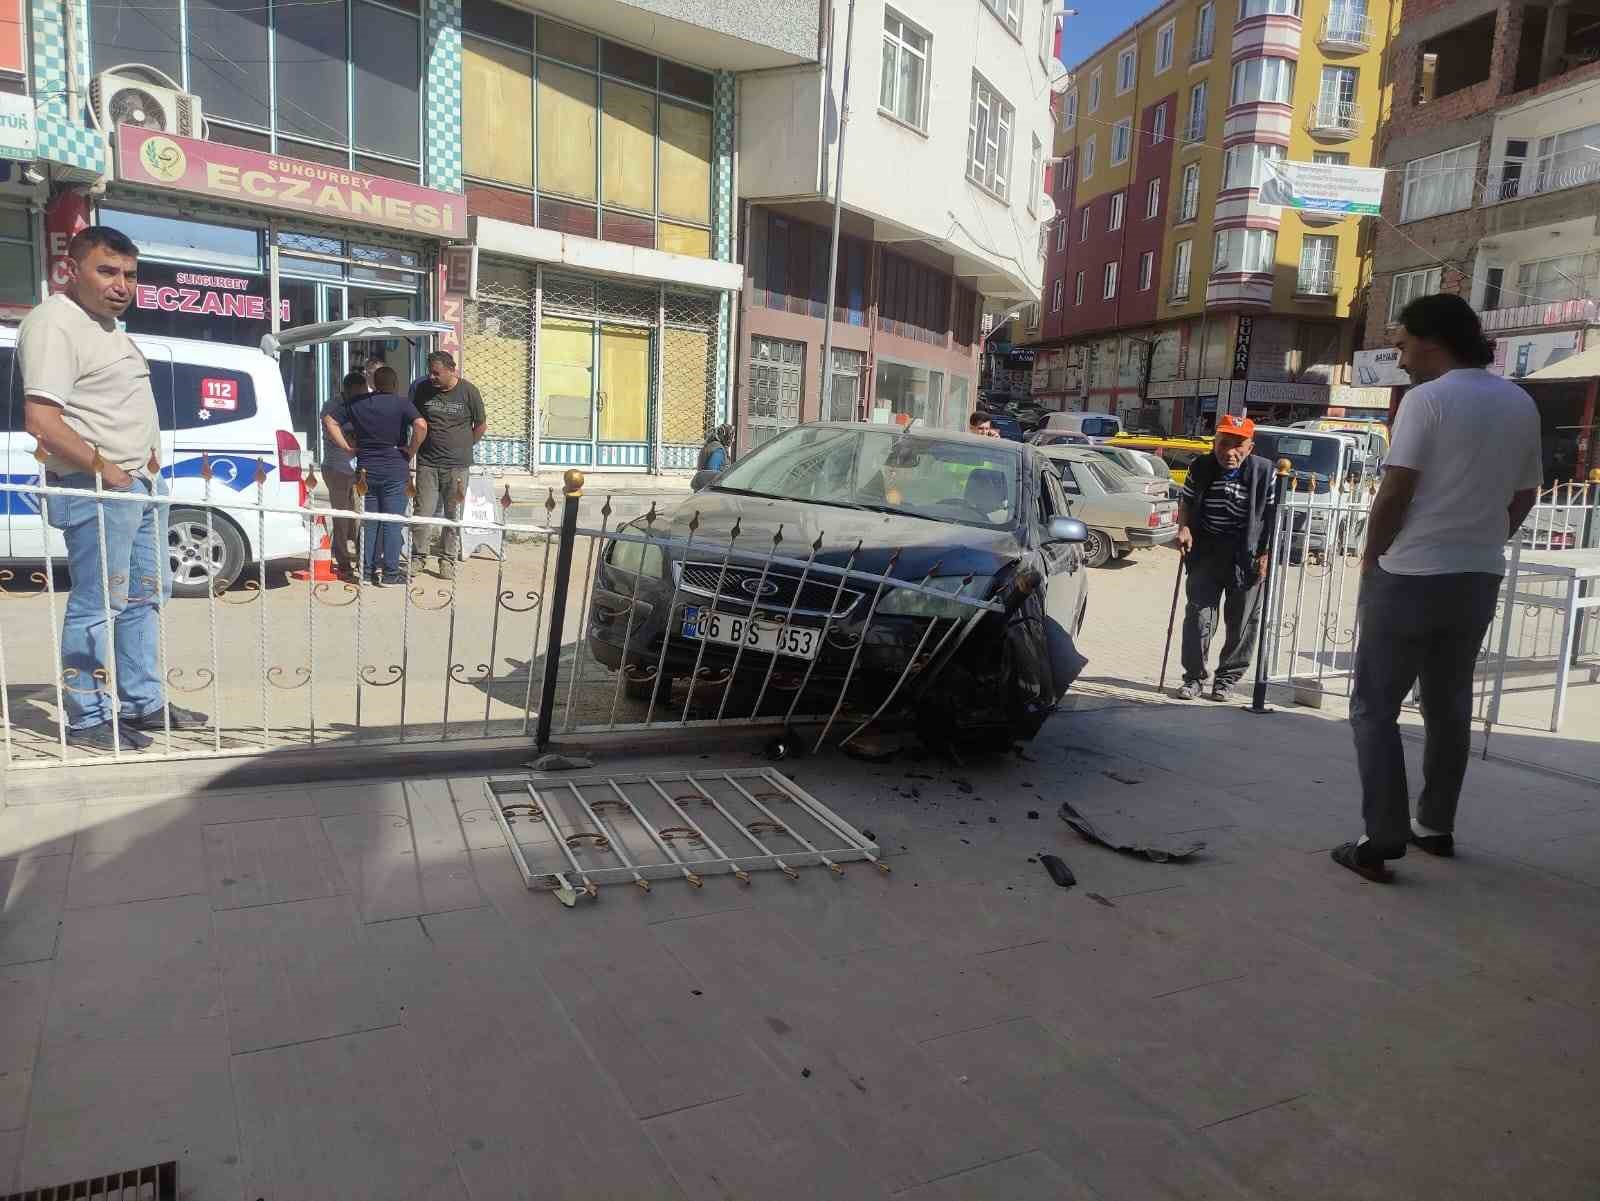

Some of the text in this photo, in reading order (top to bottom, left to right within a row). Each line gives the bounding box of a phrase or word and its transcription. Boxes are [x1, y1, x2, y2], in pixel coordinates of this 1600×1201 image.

[268, 160, 372, 190] SUNGURBEY
[206, 160, 454, 231] ECZANESİ
[176, 272, 248, 290] SUNGURBEY
[1236, 317, 1252, 370] BUHARA
[208, 382, 232, 397] 112
[698, 613, 720, 638] 06
[731, 619, 760, 645] BS
